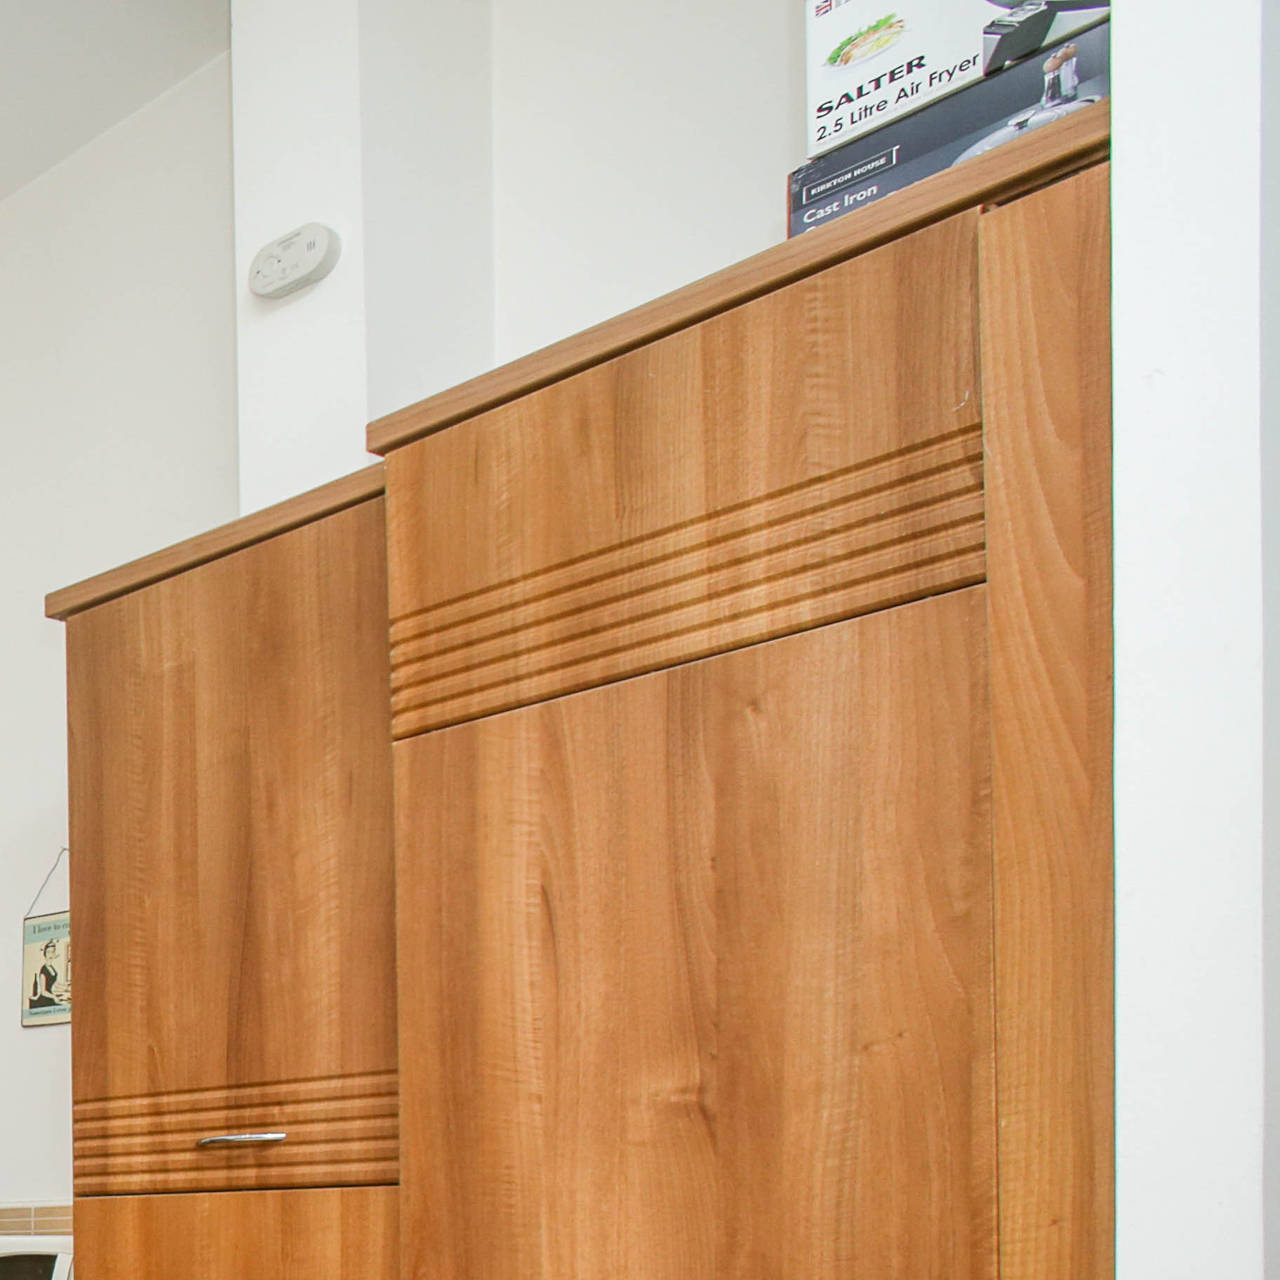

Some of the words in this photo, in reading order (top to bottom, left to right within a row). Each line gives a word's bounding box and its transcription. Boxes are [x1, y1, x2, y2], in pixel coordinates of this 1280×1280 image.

[815, 55, 926, 119] SALTER
[815, 117, 844, 142] 2.5
[850, 99, 889, 126] Litre
[894, 81, 922, 104] Air
[928, 53, 980, 88] Fryer
[810, 172, 852, 195] KIRKTON
[853, 156, 888, 177] HOUSE
[803, 201, 841, 223] Cast
[843, 185, 880, 207] Iron
